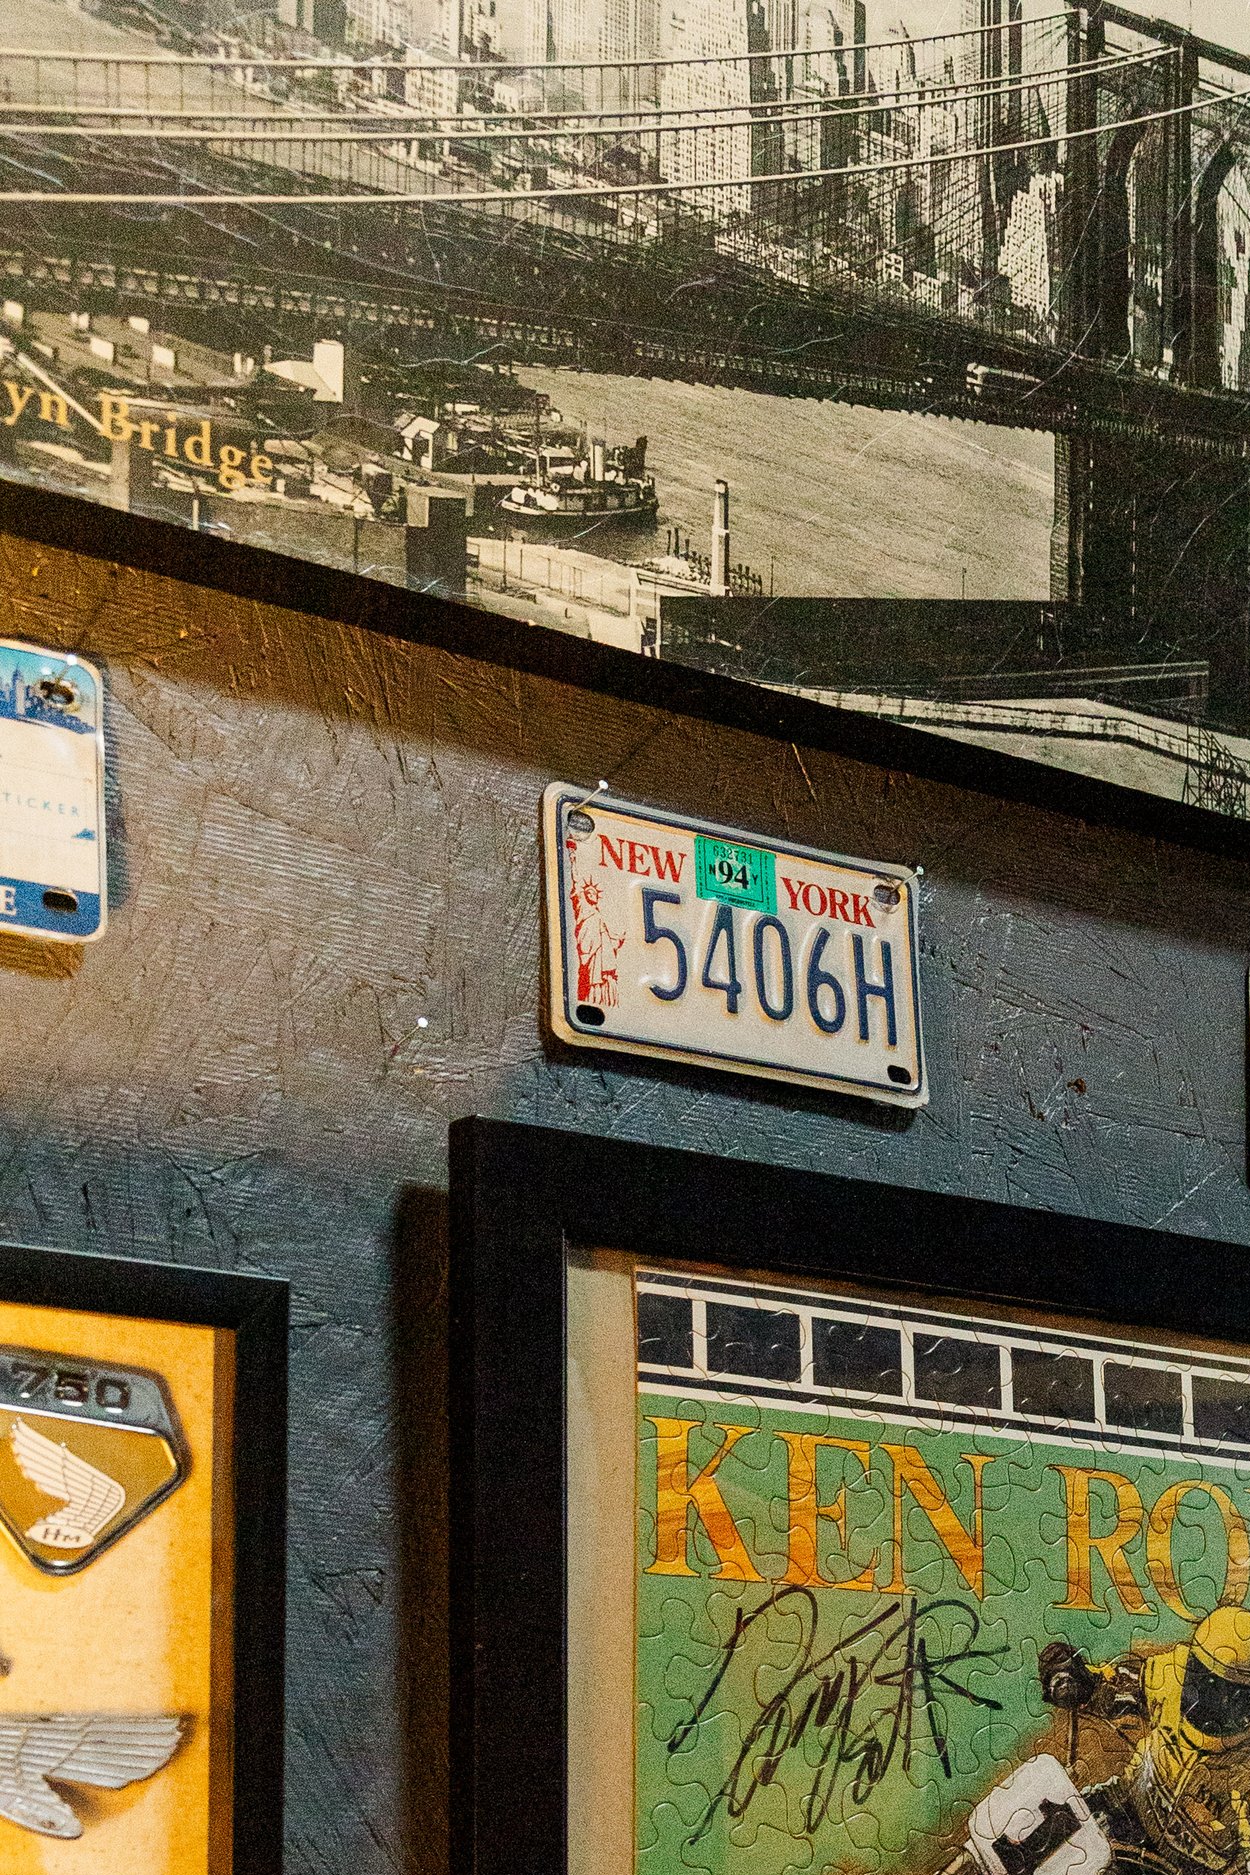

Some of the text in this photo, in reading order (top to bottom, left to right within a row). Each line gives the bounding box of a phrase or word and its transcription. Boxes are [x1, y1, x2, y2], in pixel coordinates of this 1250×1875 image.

[2, 379, 275, 490] yn Bridge
[598, 833, 687, 884] NEW
[780, 875, 877, 930] YORK
[718, 860, 749, 890] 94
[641, 887, 898, 1047] 5406H
[10, 1362, 131, 1414] 750
[643, 1414, 997, 1602] KEN
